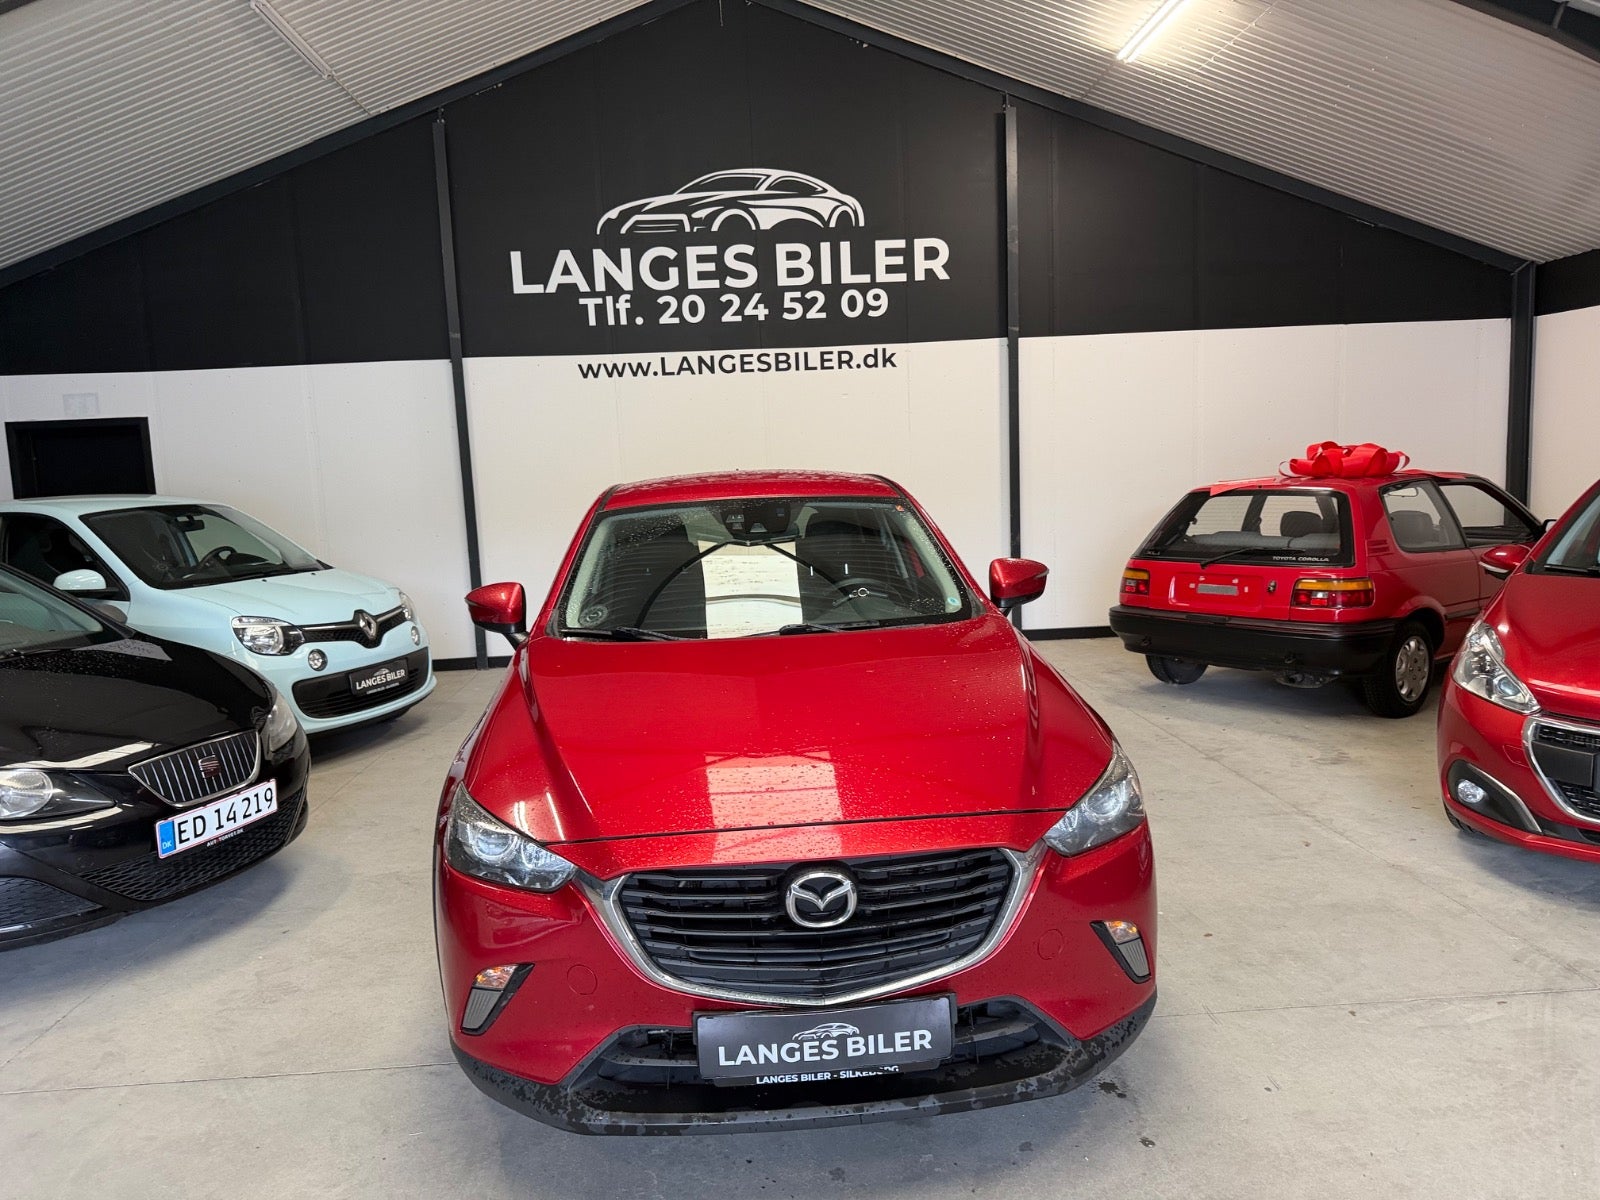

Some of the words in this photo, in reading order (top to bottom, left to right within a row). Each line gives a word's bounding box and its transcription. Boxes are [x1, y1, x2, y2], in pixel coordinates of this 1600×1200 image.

[510, 244, 758, 294] LANGES
[775, 237, 951, 287] BILER
[578, 293, 644, 326] Tlf.
[657, 294, 706, 324] 20
[719, 292, 769, 322] 24
[782, 290, 827, 320] 52
[840, 288, 889, 317] 09
[577, 347, 898, 379] www.LANGESBILER.dk
[355, 674, 386, 690] LANGES
[386, 669, 406, 681] BILER
[162, 840, 173, 850] DK
[177, 815, 207, 845] ED
[718, 1039, 839, 1066] LANGES
[847, 1029, 932, 1057] BILER
[756, 1074, 798, 1085] LANGES
[800, 1071, 831, 1082] BILER
